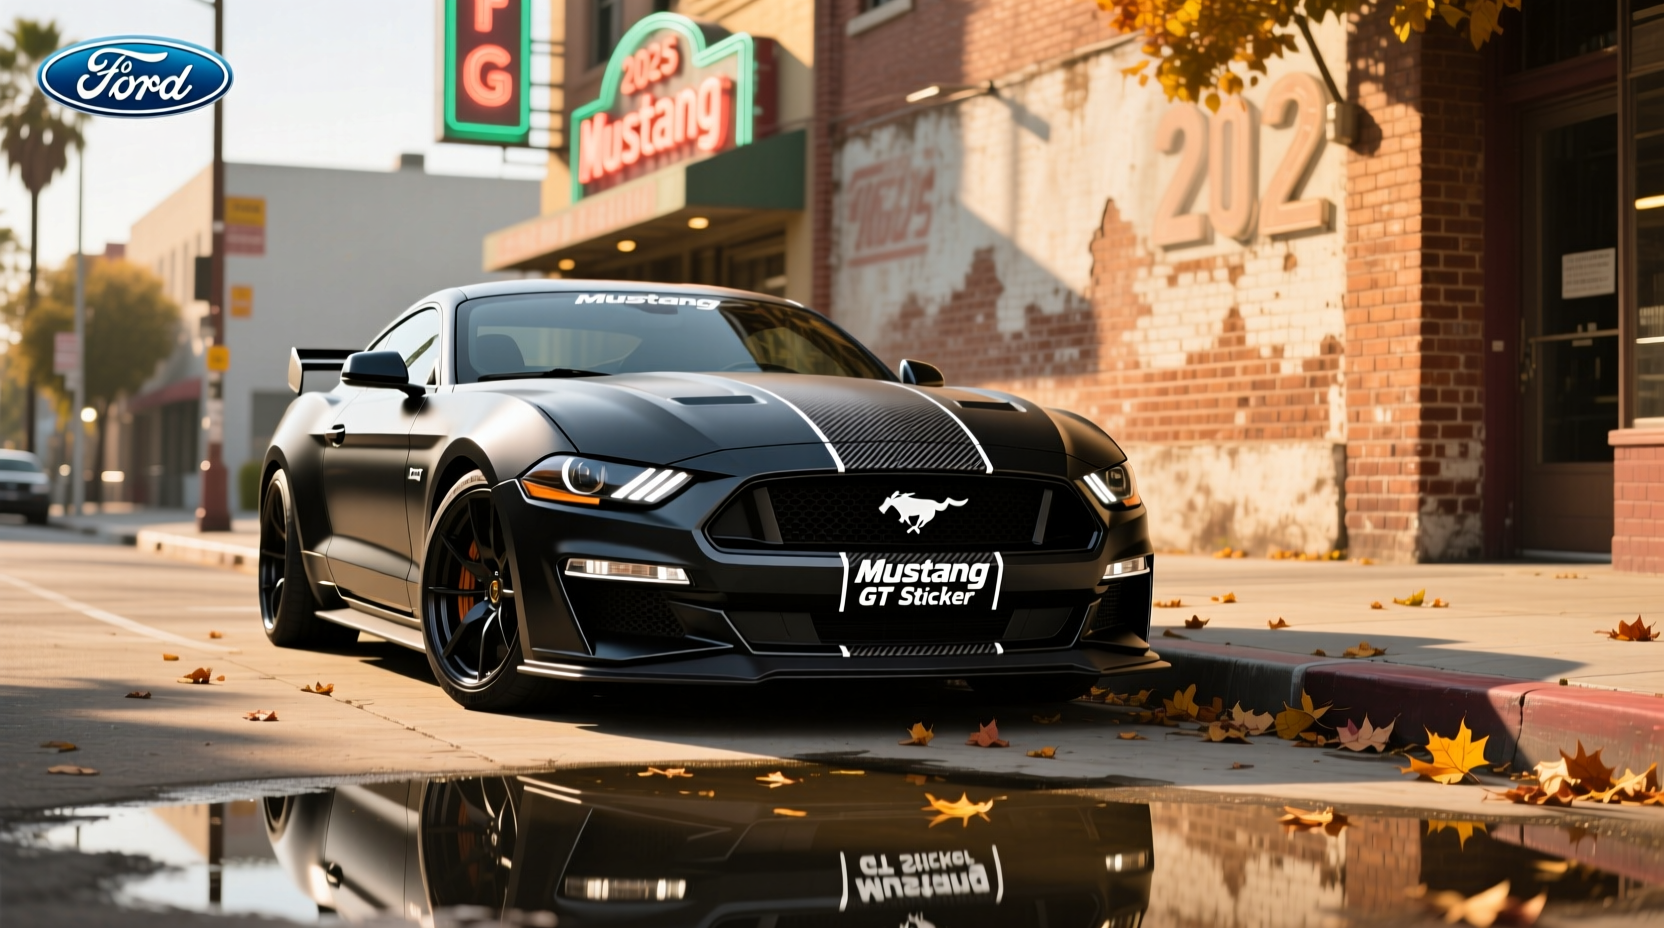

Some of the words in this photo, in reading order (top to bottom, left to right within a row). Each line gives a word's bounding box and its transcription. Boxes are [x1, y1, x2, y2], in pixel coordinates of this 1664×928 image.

[620, 34, 679, 95] 2025
[578, 76, 732, 184] Mustang
[1153, 72, 1331, 247] 202
[575, 293, 721, 310] Mustang
[854, 559, 990, 590] Mustang
[859, 586, 895, 606] GT
[898, 586, 975, 606] Sticker
